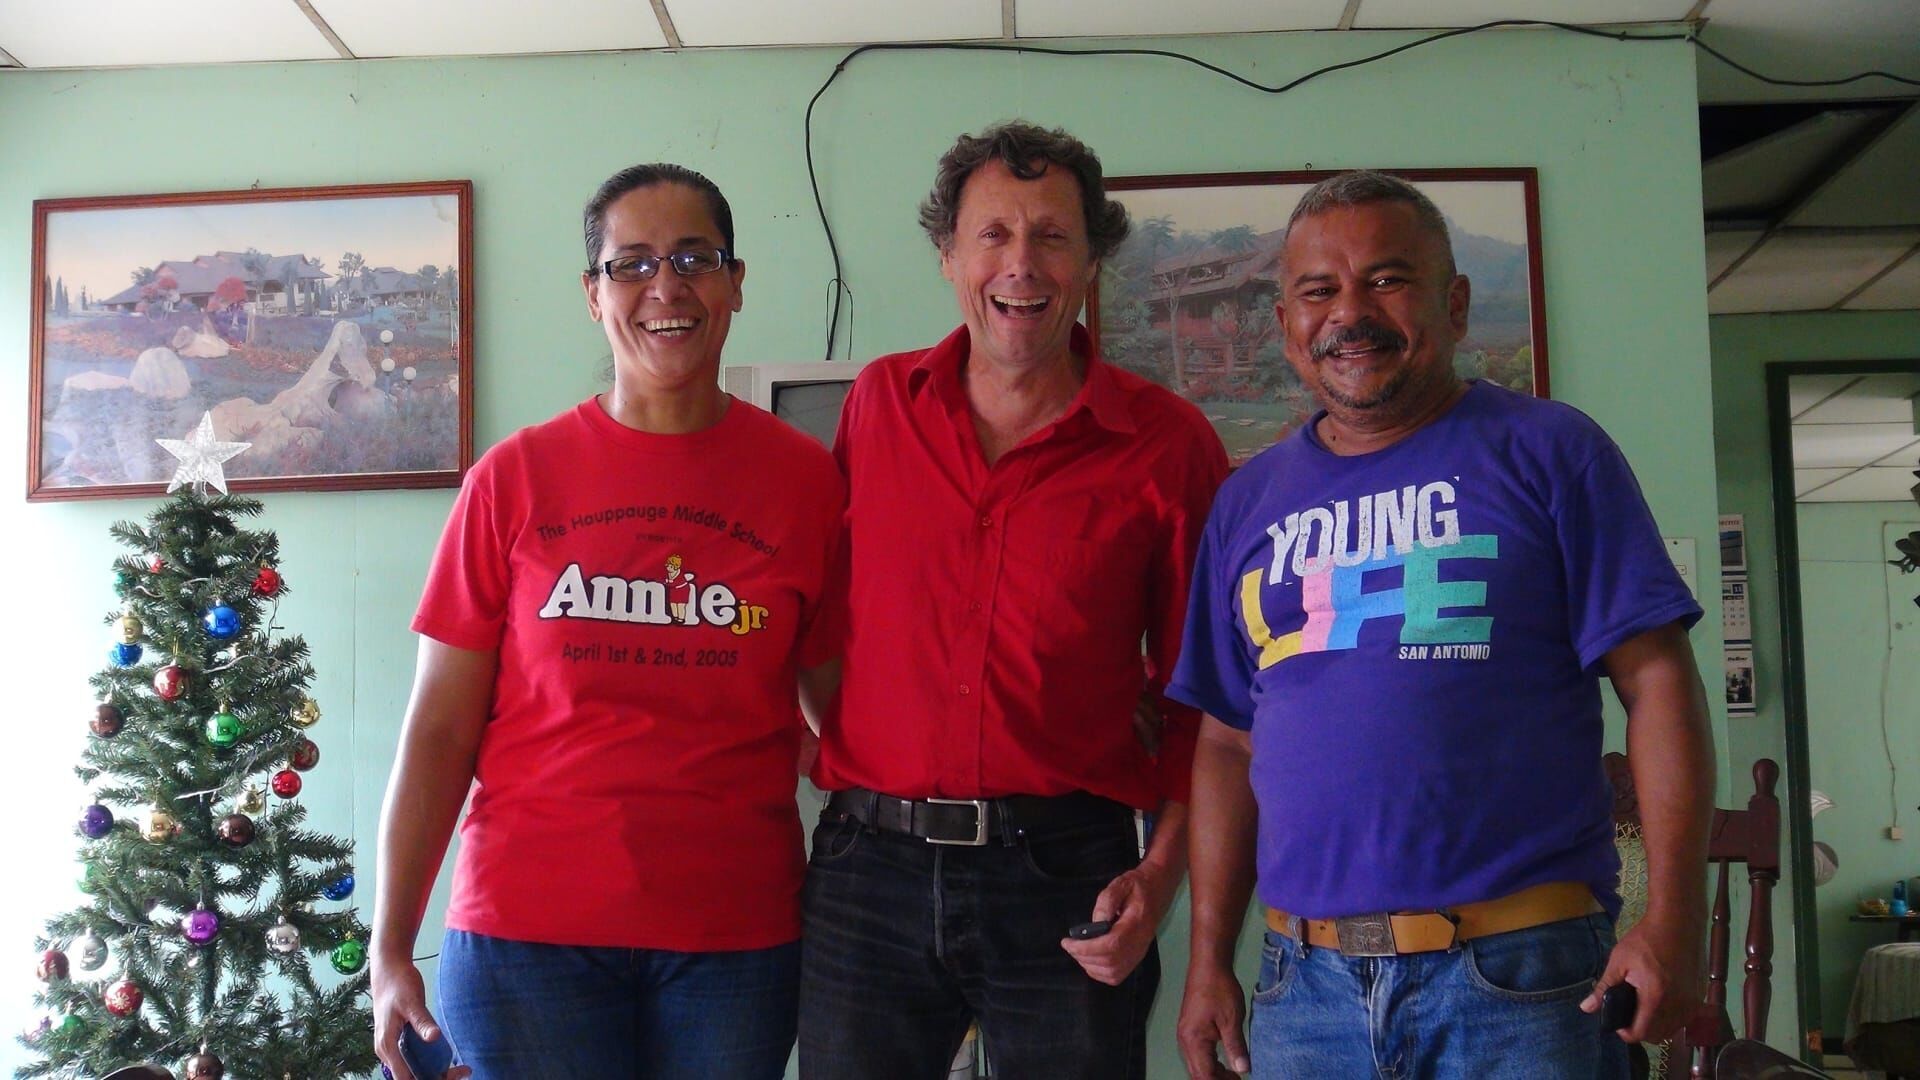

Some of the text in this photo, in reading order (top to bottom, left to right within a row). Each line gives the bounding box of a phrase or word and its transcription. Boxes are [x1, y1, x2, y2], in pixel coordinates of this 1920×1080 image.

[537, 504, 780, 557] The Hauppauge Middle School
[1266, 480, 1461, 585] YOUNG
[538, 562, 736, 627] Annie
[1240, 534, 1499, 671] LIFE
[562, 643, 739, 668] April 1st & 2nd, 2005
[1398, 645, 1490, 660] SAN ANTONIO
